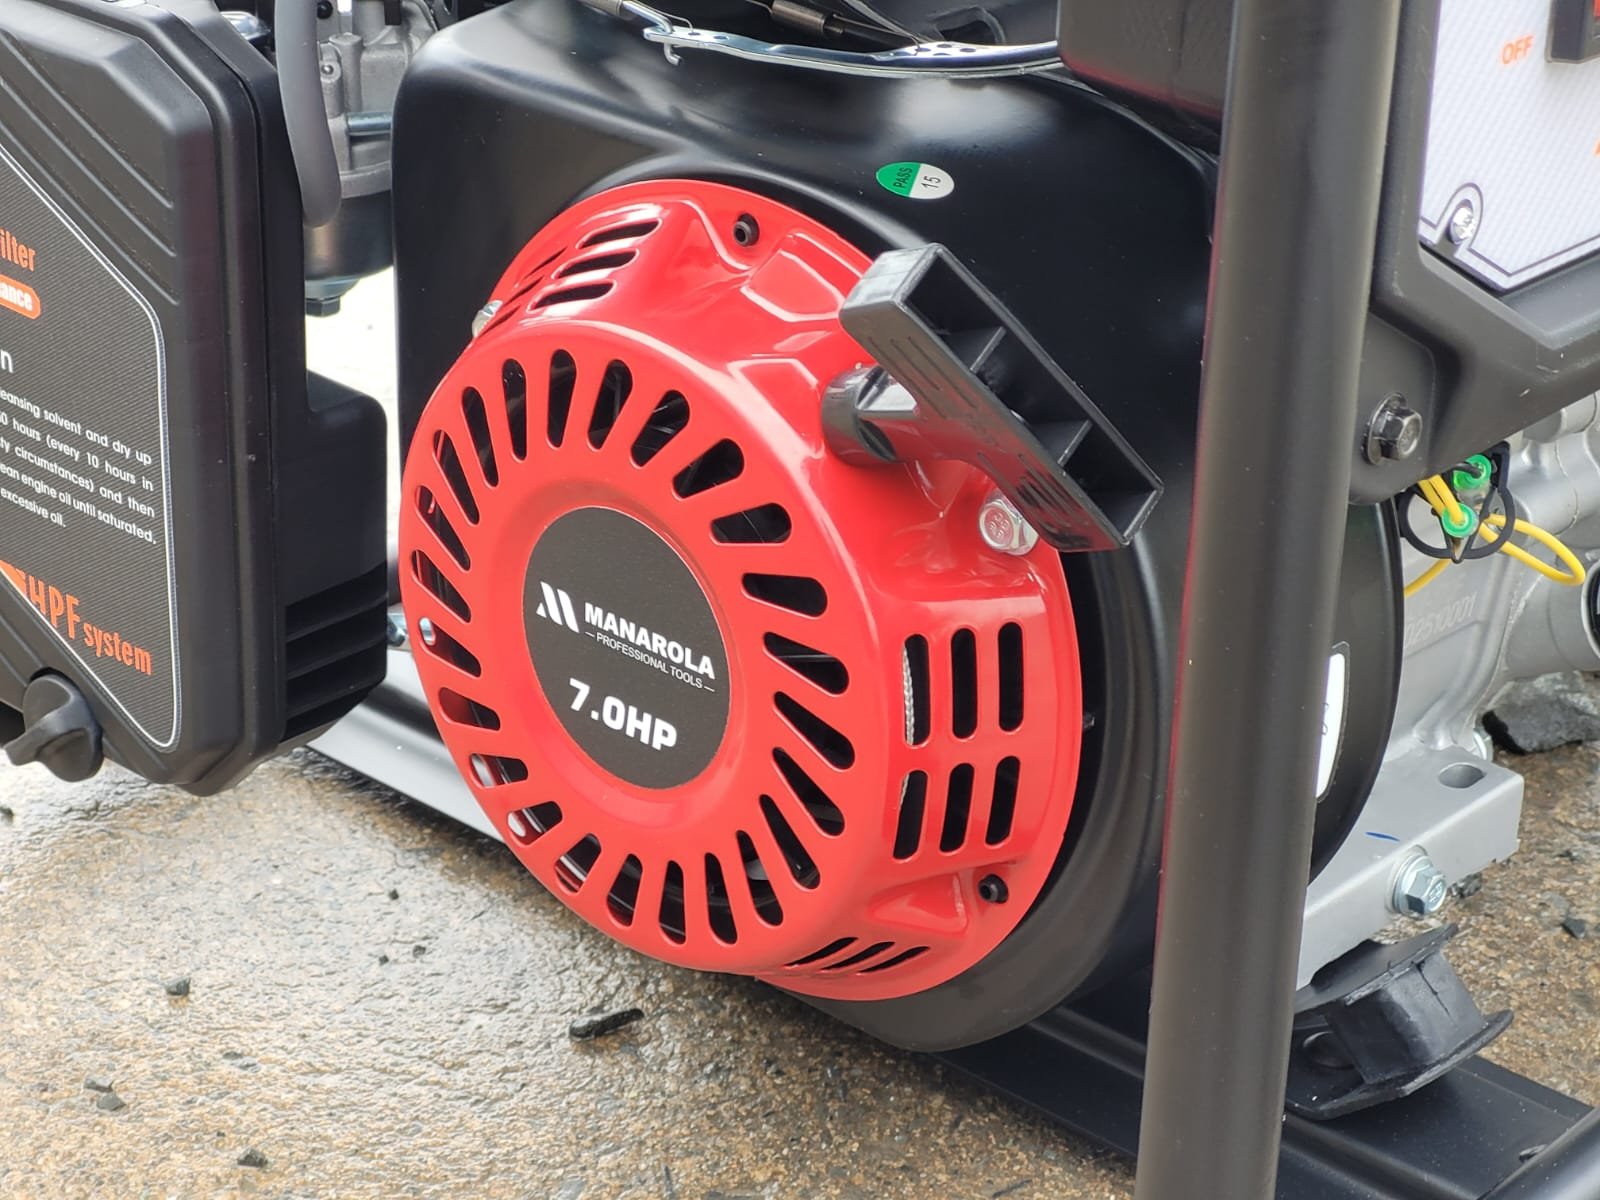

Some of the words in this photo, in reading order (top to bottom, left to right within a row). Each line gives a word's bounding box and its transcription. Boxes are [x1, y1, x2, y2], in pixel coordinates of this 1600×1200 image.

[1501, 35, 1534, 65] OFF
[892, 167, 913, 189] PASS
[920, 175, 942, 189] 15
[12, 417, 41, 442] hours
[46, 434, 80, 462] (every
[86, 452, 99, 469] 10
[105, 460, 136, 485] hours
[141, 476, 154, 492] in
[43, 409, 81, 436] solvent
[85, 429, 109, 448] and
[112, 440, 131, 459] dry
[135, 449, 152, 466] up
[0, 487, 49, 519] excessive
[50, 512, 67, 528] oil.
[14, 446, 94, 493] circumstances)
[99, 486, 123, 505] and
[127, 496, 155, 518] then
[21, 474, 57, 499] engine
[58, 492, 72, 506] oil
[72, 498, 96, 518] until
[97, 510, 157, 545] saturated.
[28, 575, 81, 640] HPF
[83, 622, 153, 676] system
[584, 601, 716, 680] MANAROLA
[596, 632, 669, 674] PROFESSIONAL
[669, 665, 703, 690] TOOLS
[569, 677, 678, 751] 7.0HP
